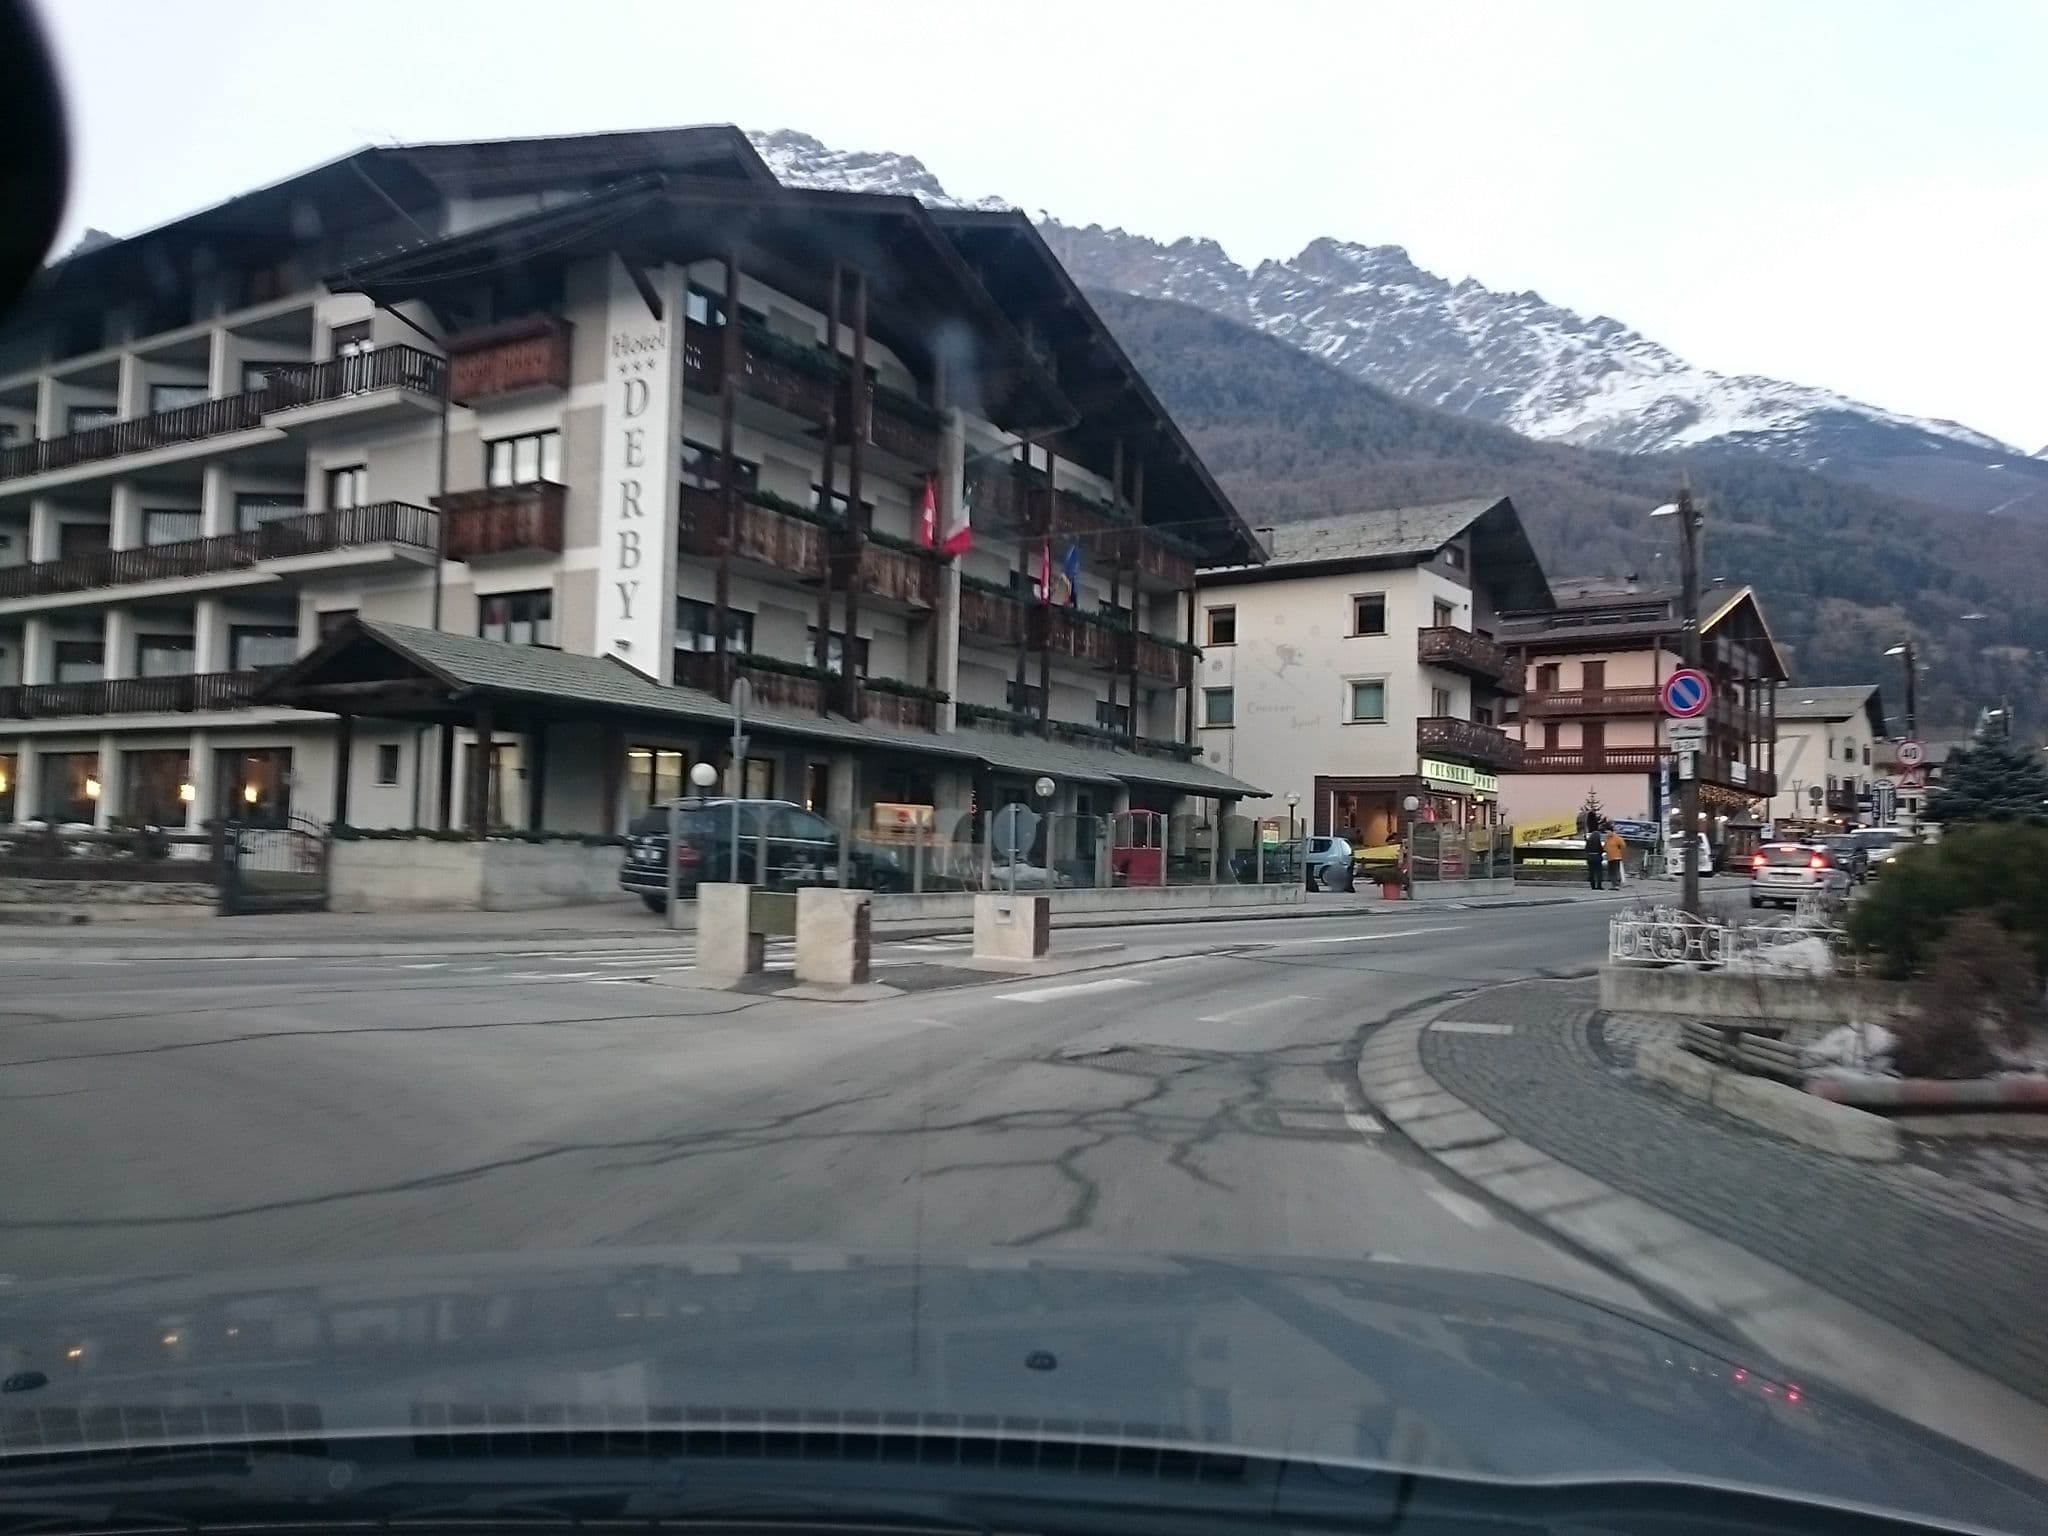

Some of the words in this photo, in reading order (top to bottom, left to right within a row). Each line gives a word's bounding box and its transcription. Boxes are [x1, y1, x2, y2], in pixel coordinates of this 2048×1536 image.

[615, 377, 650, 620] DERBY
[1901, 746, 1917, 759] 40
[1473, 774, 1496, 790] SPORT
